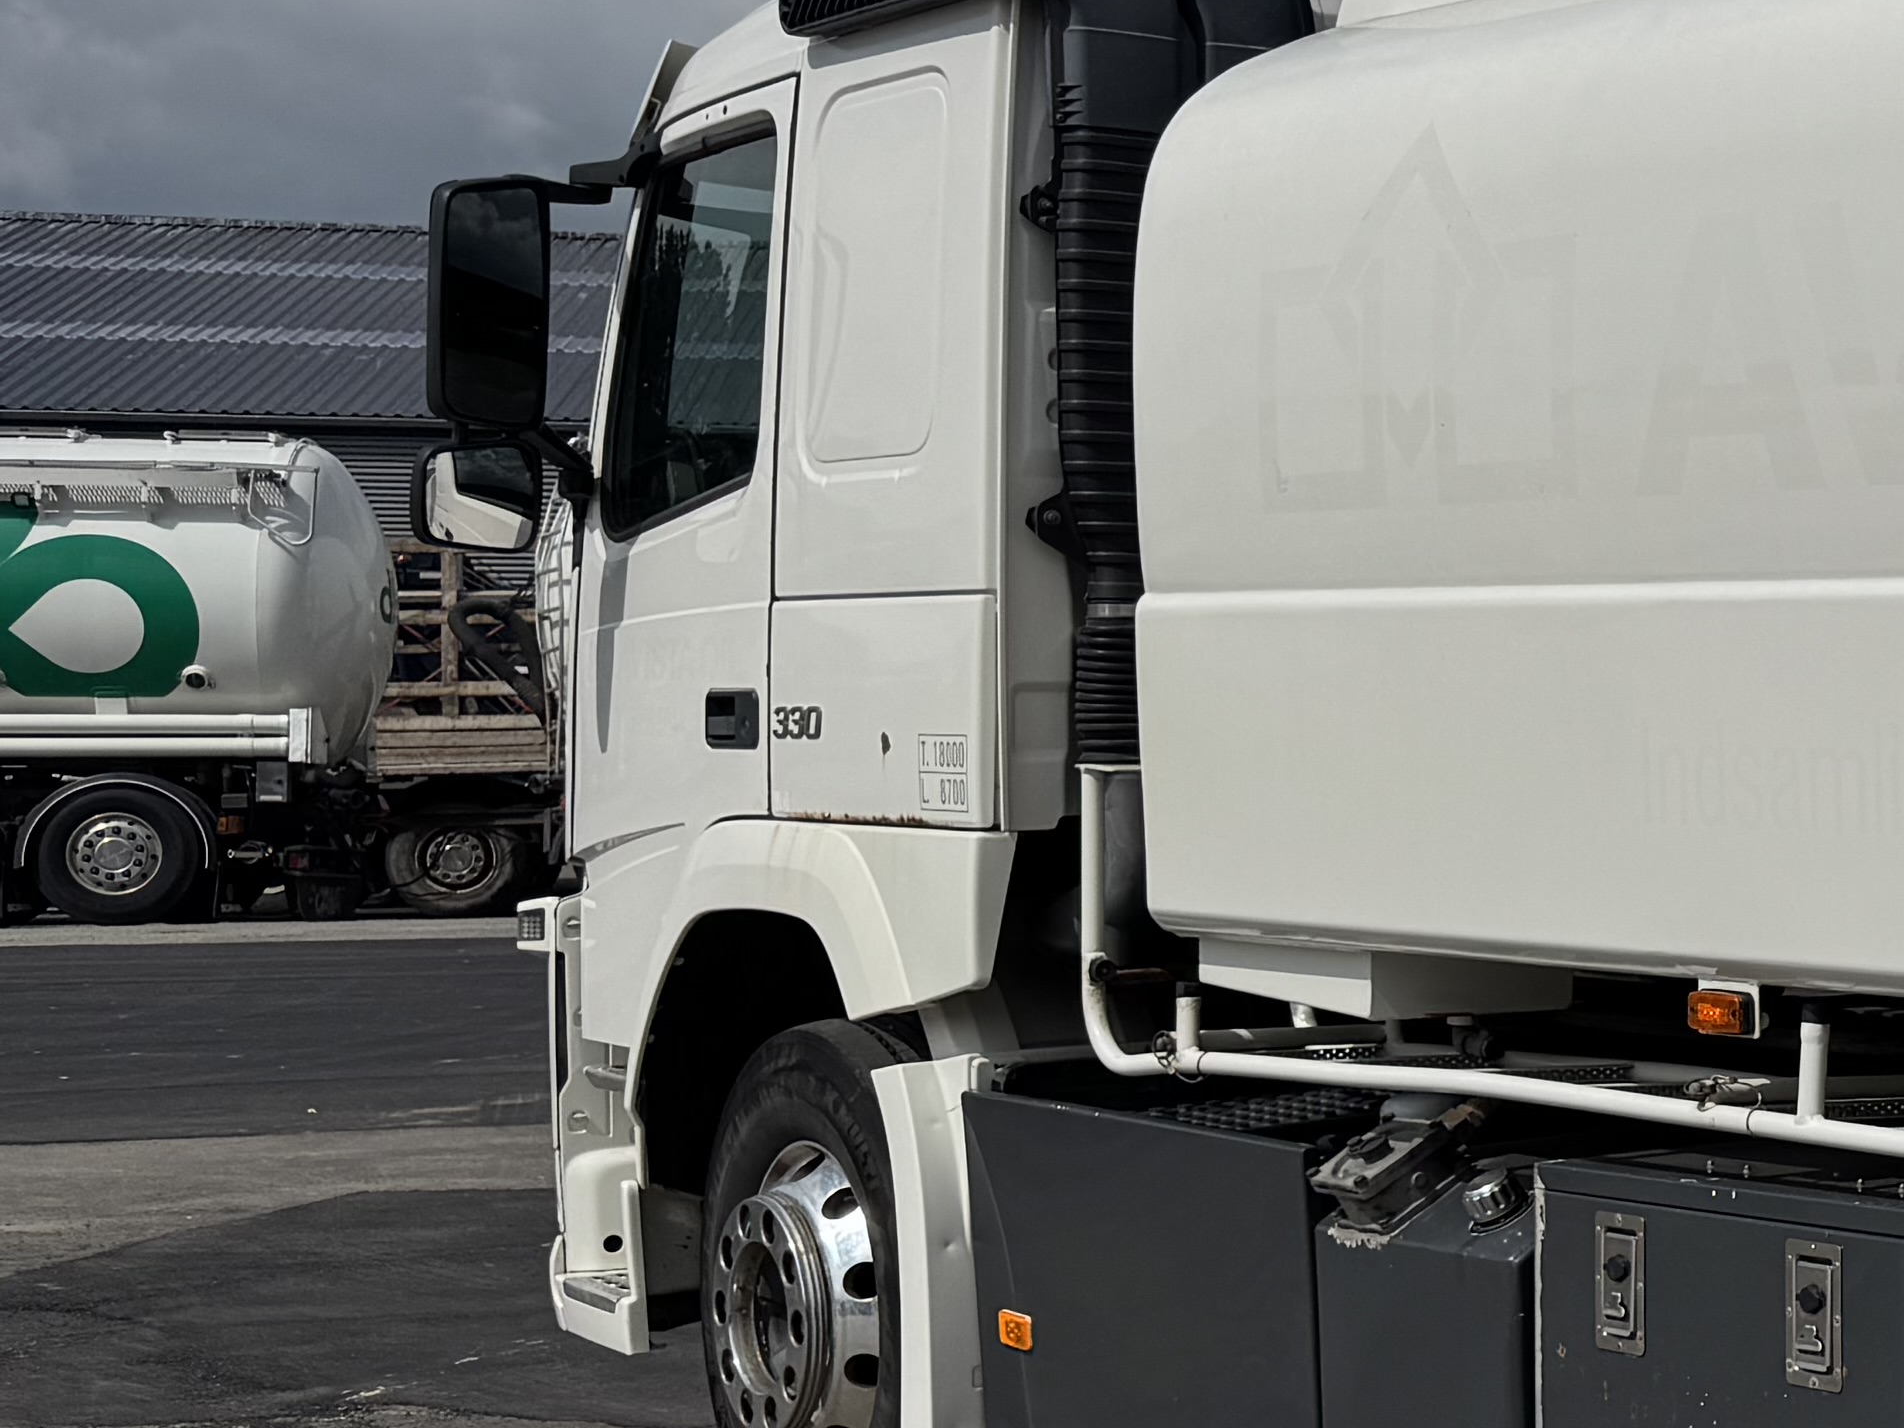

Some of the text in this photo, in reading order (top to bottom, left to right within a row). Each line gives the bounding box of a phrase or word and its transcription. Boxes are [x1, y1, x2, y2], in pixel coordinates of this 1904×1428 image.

[772, 705, 822, 740] 330
[933, 740, 965, 769] 18000
[939, 778, 966, 806] 8700
